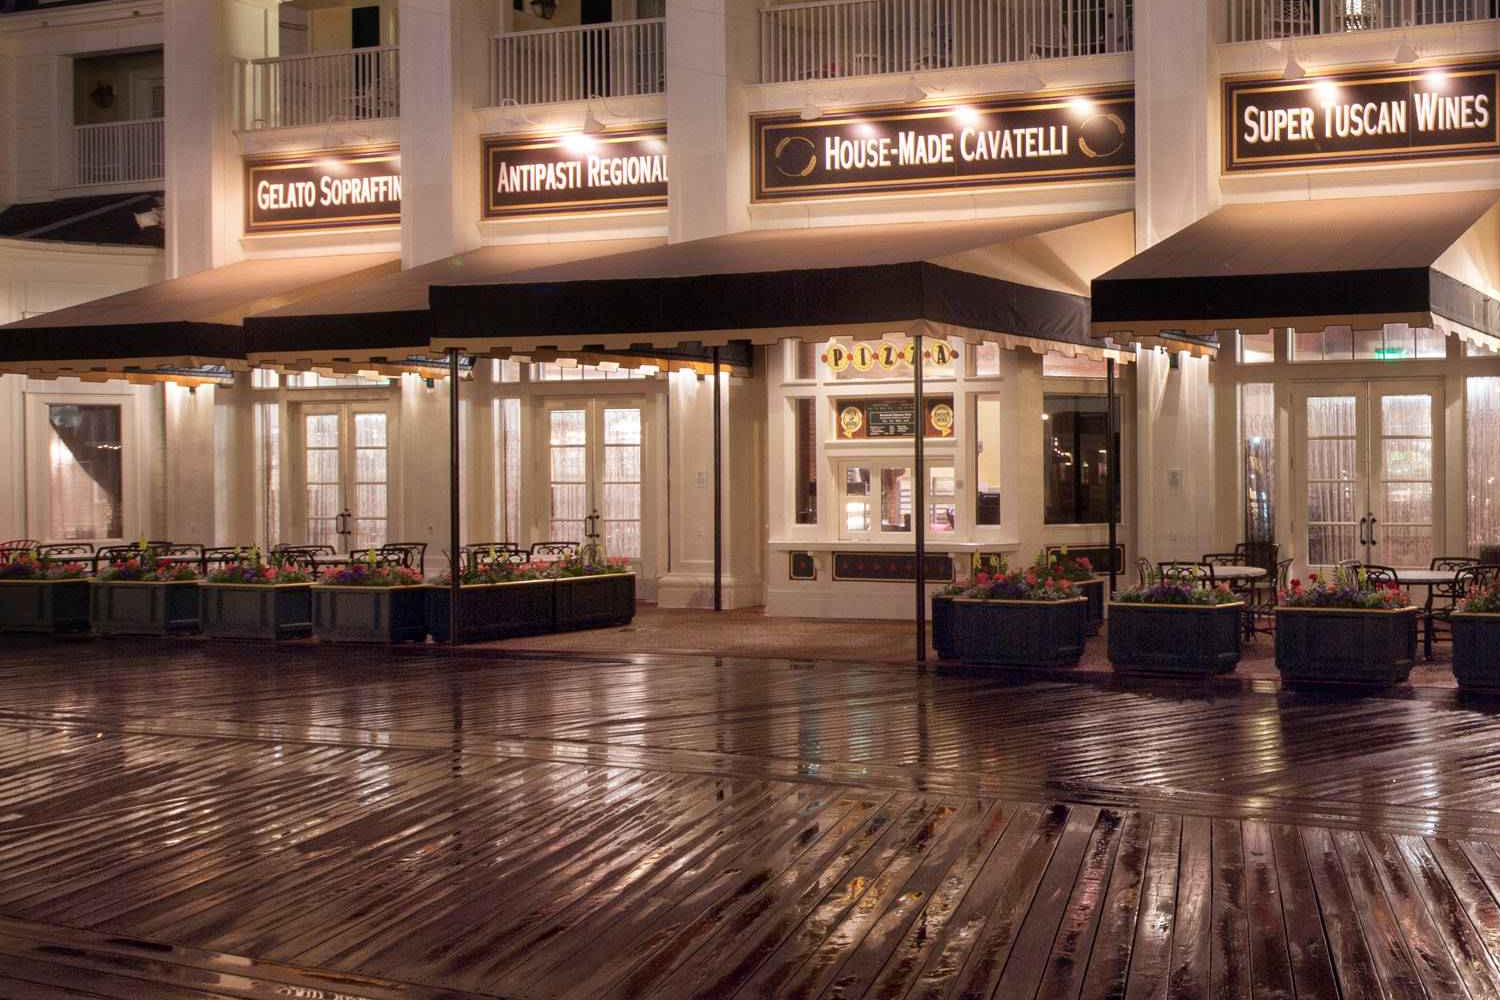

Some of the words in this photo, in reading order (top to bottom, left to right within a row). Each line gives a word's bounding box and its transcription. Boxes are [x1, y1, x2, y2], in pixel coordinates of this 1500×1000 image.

[1244, 105, 1315, 144] SUPER
[1321, 99, 1407, 139] TUSCAN
[1414, 91, 1489, 132] WINES
[825, 131, 954, 171] HOUSE-MADE
[959, 125, 1069, 162] CAVATELLI
[257, 180, 316, 210] GELATO
[497, 161, 582, 194] ANTIPASTI
